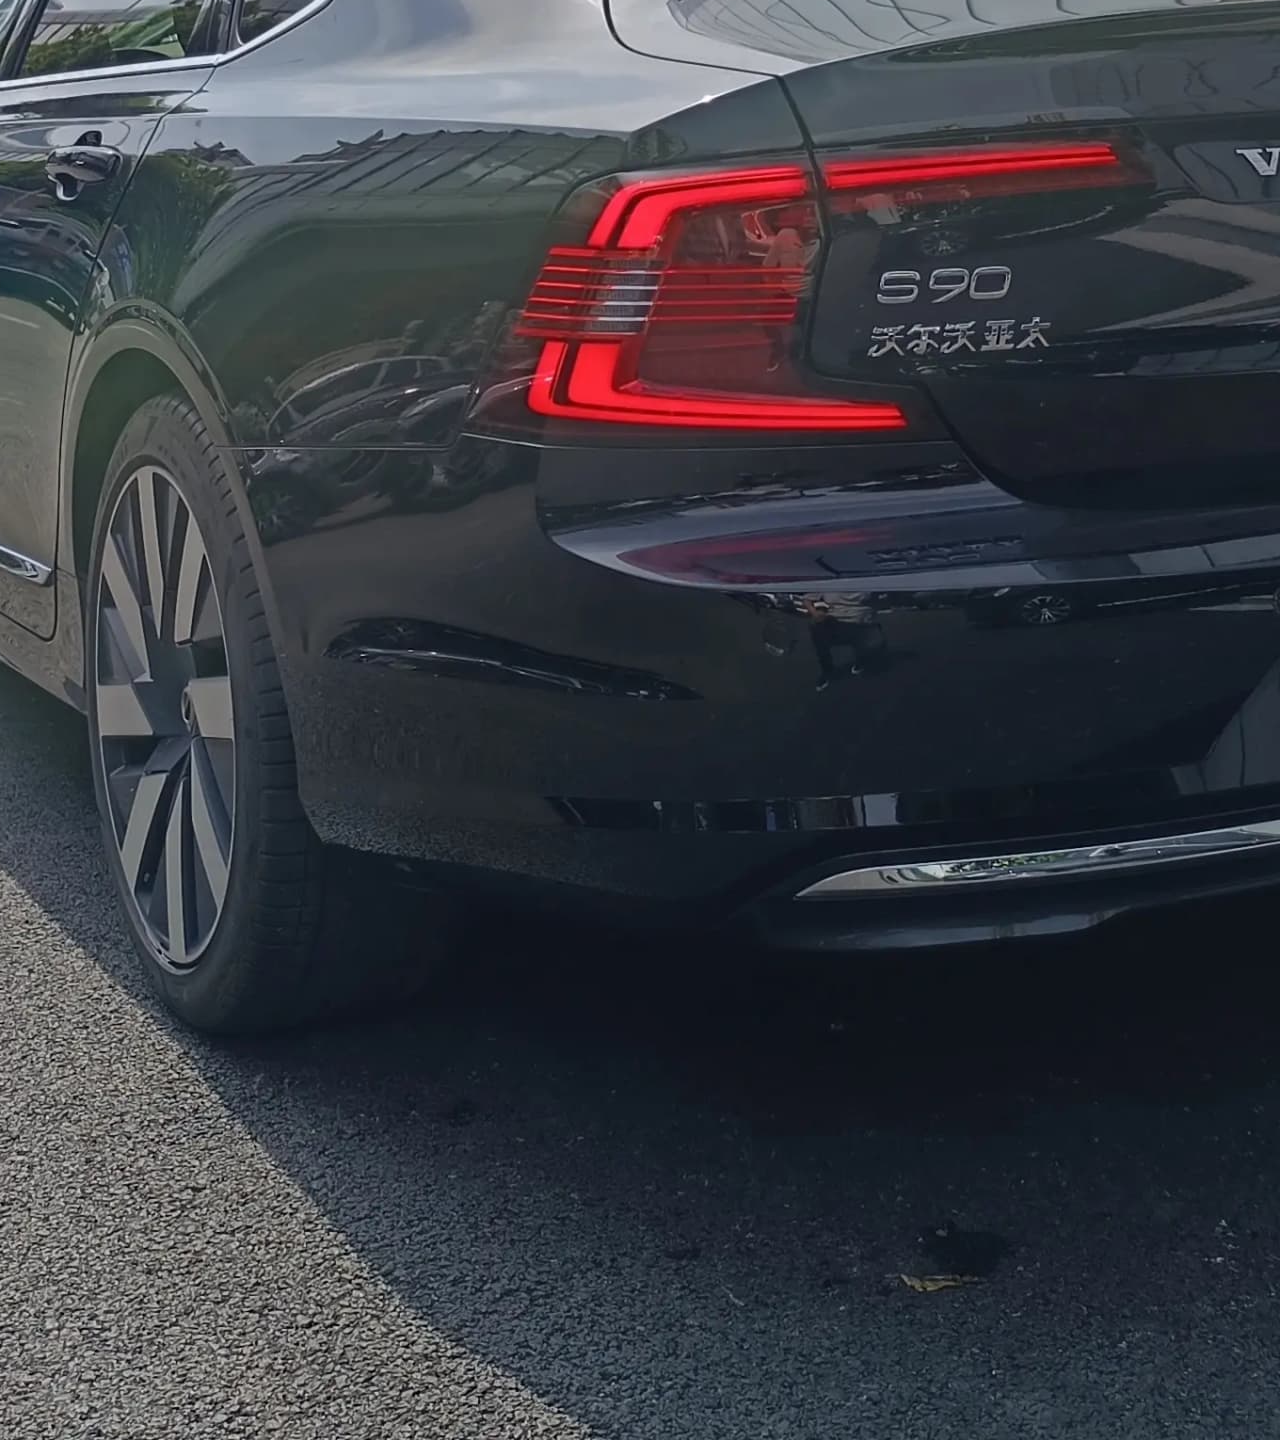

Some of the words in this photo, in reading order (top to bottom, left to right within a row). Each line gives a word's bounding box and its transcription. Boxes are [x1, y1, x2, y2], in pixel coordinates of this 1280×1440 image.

[877, 266, 1012, 304] S90
[868, 316, 1051, 358] 沃尔沃亚太
